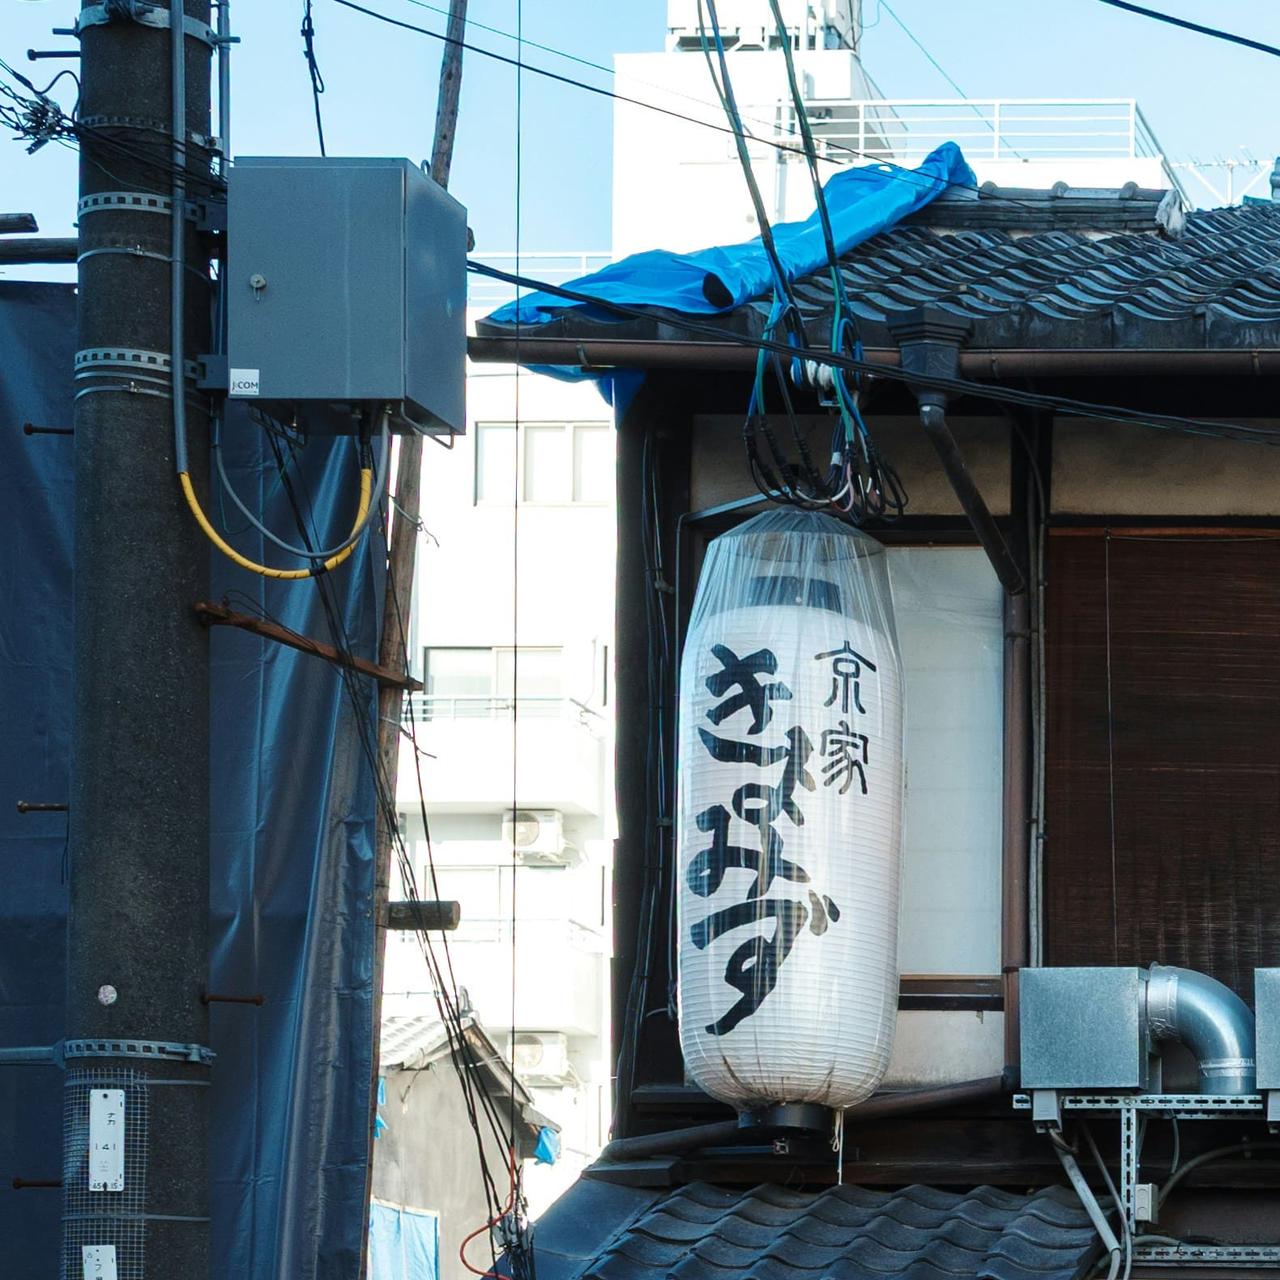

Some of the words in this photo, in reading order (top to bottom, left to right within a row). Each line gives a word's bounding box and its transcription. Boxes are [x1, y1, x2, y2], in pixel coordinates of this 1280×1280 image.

[686, 643, 840, 1036] きよみず
[815, 640, 876, 795] 京家
